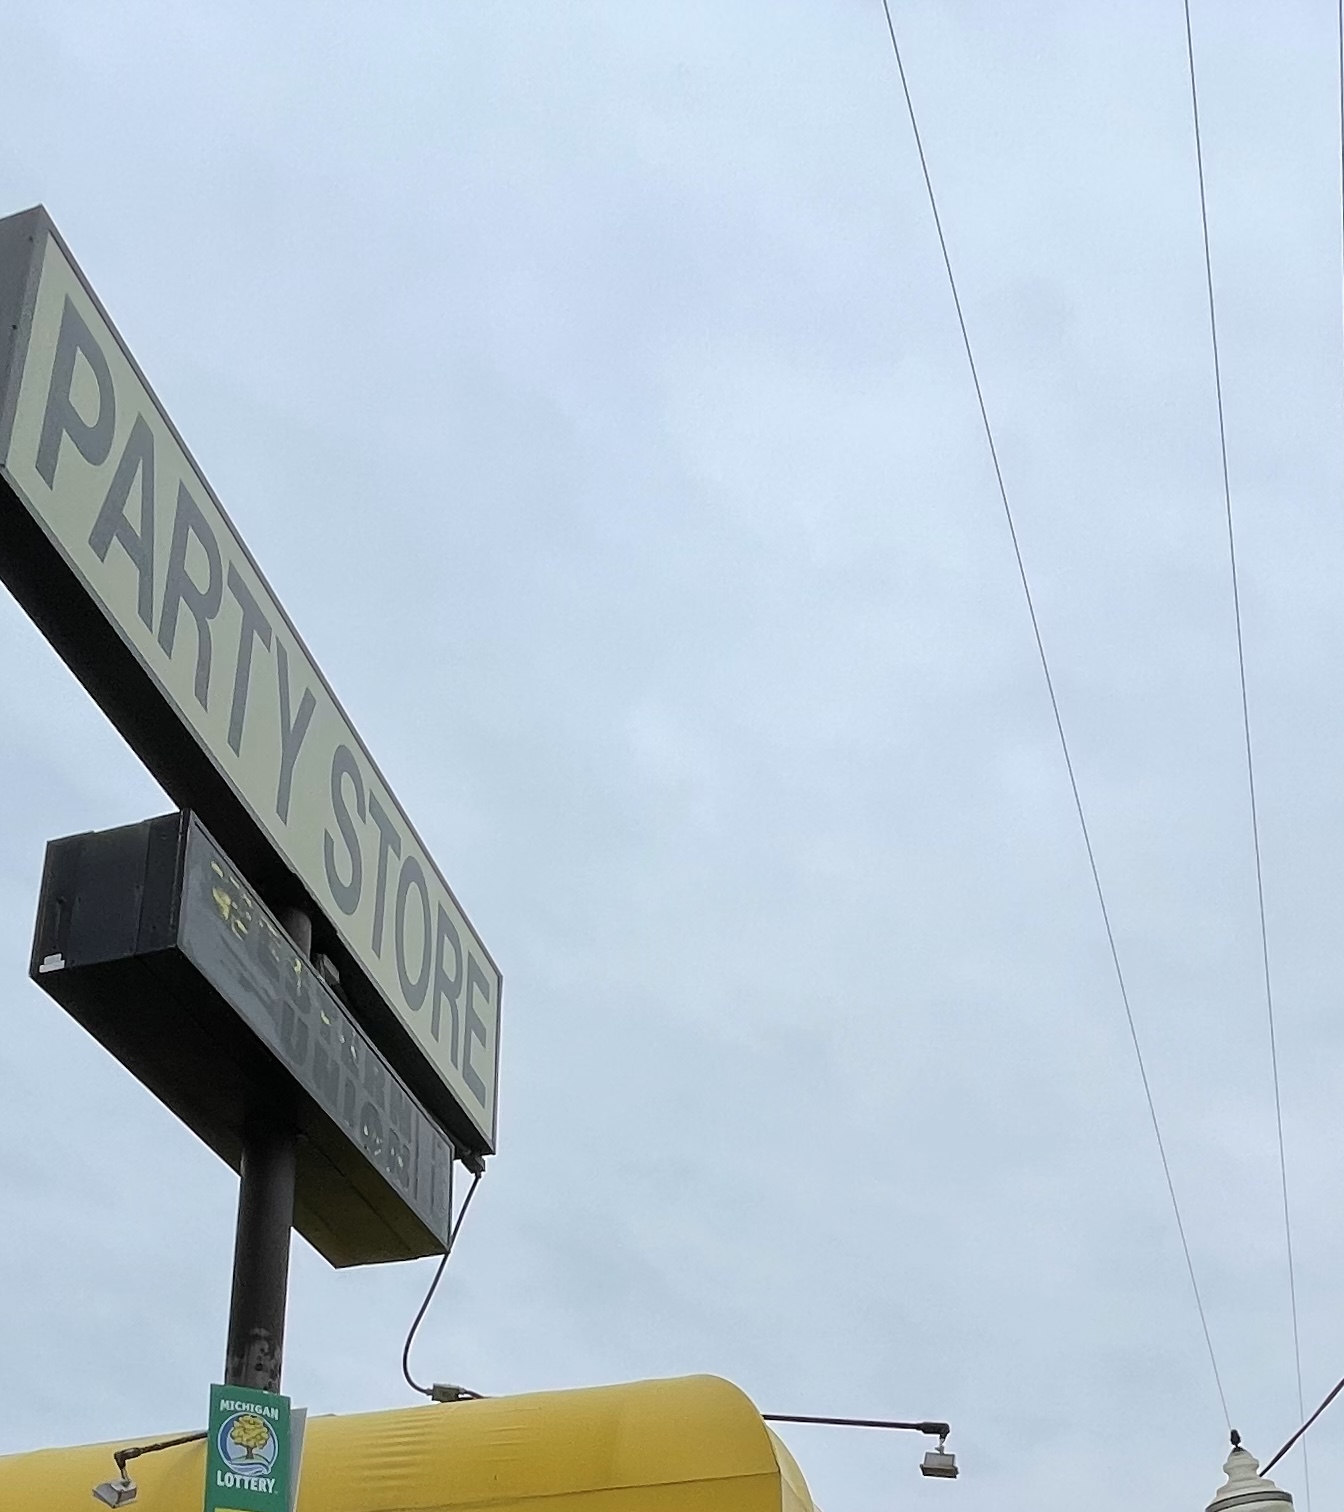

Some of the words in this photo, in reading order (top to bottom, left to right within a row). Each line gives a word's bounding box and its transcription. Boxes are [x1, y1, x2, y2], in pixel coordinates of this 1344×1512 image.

[34, 292, 318, 825] PARTY
[323, 744, 492, 1110] STORE
[219, 1398, 279, 1422] MICHIGAN
[216, 1469, 277, 1495] LOTTERY
